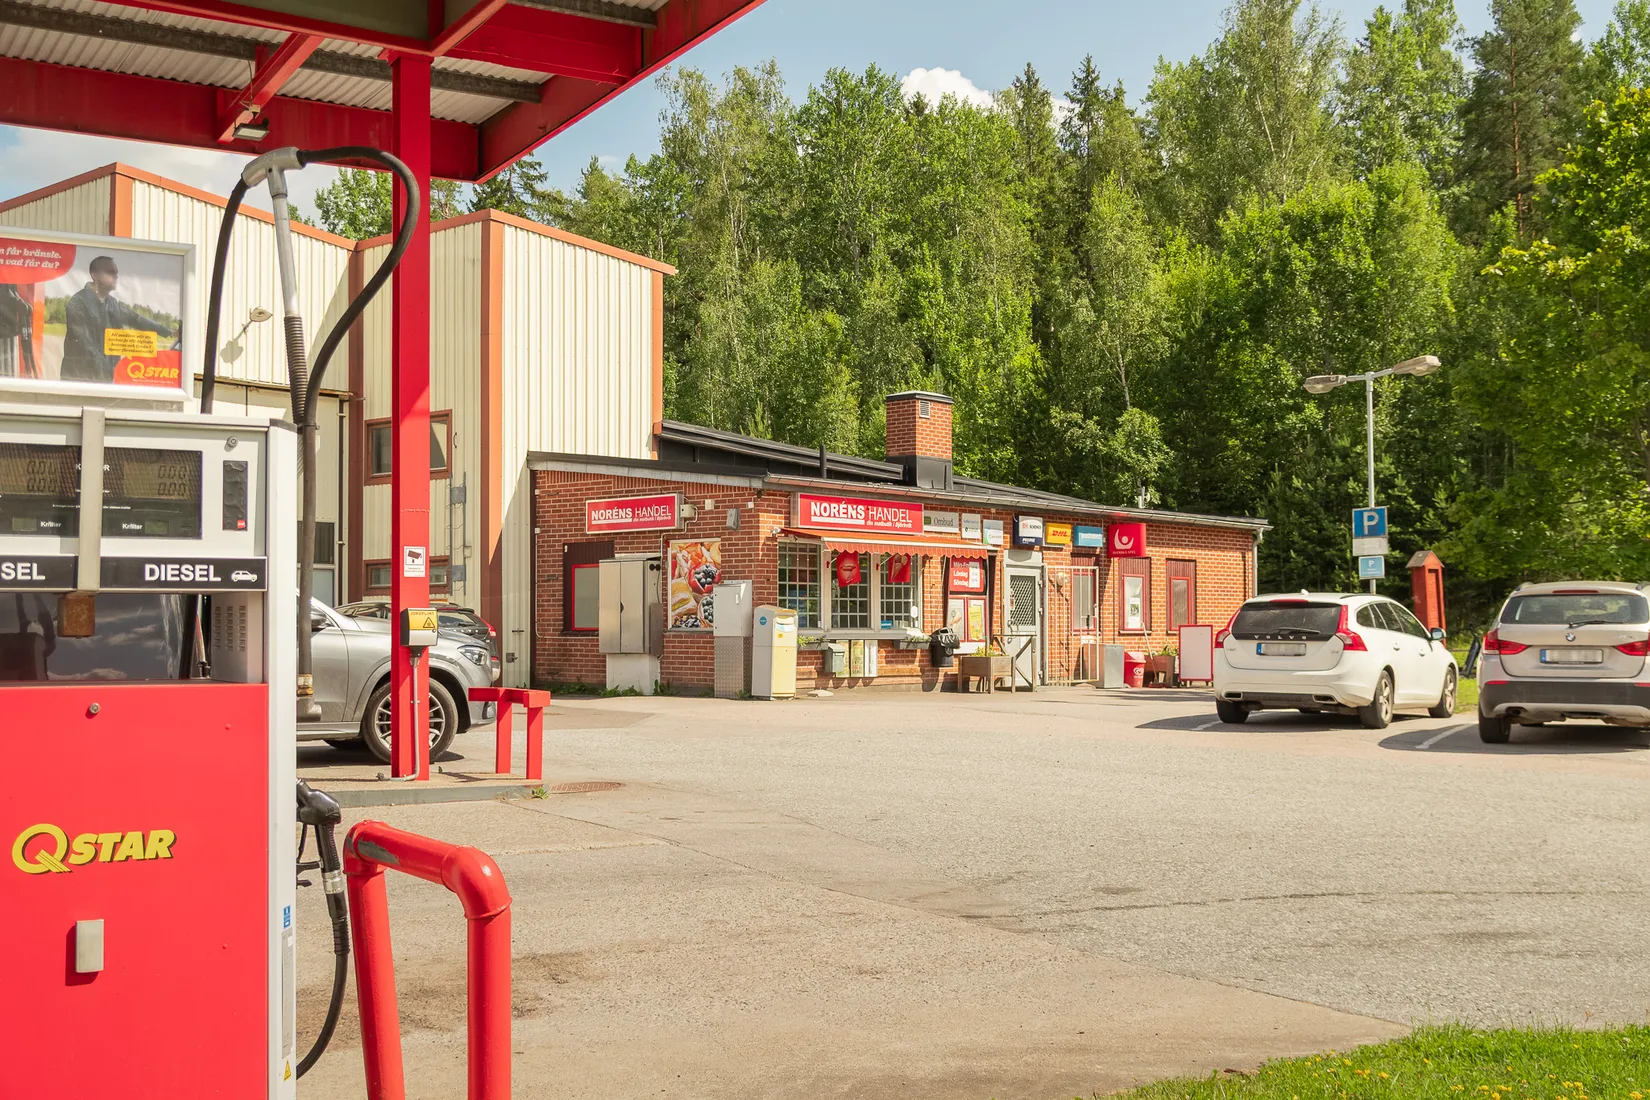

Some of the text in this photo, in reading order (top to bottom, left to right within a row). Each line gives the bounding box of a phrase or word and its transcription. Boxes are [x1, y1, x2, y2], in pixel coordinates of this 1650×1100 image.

[6, 247, 22, 256] får
[23, 248, 62, 259] bränsle.
[6, 258, 23, 266] vad
[24, 259, 40, 268] får
[41, 260, 60, 269] du?
[591, 504, 672, 520] NORÉNS HANDEL
[810, 501, 913, 523] NORÉNS HANDEL
[933, 516, 954, 527] Ombud
[1363, 511, 1379, 535] P
[144, 563, 222, 582] DIESEL
